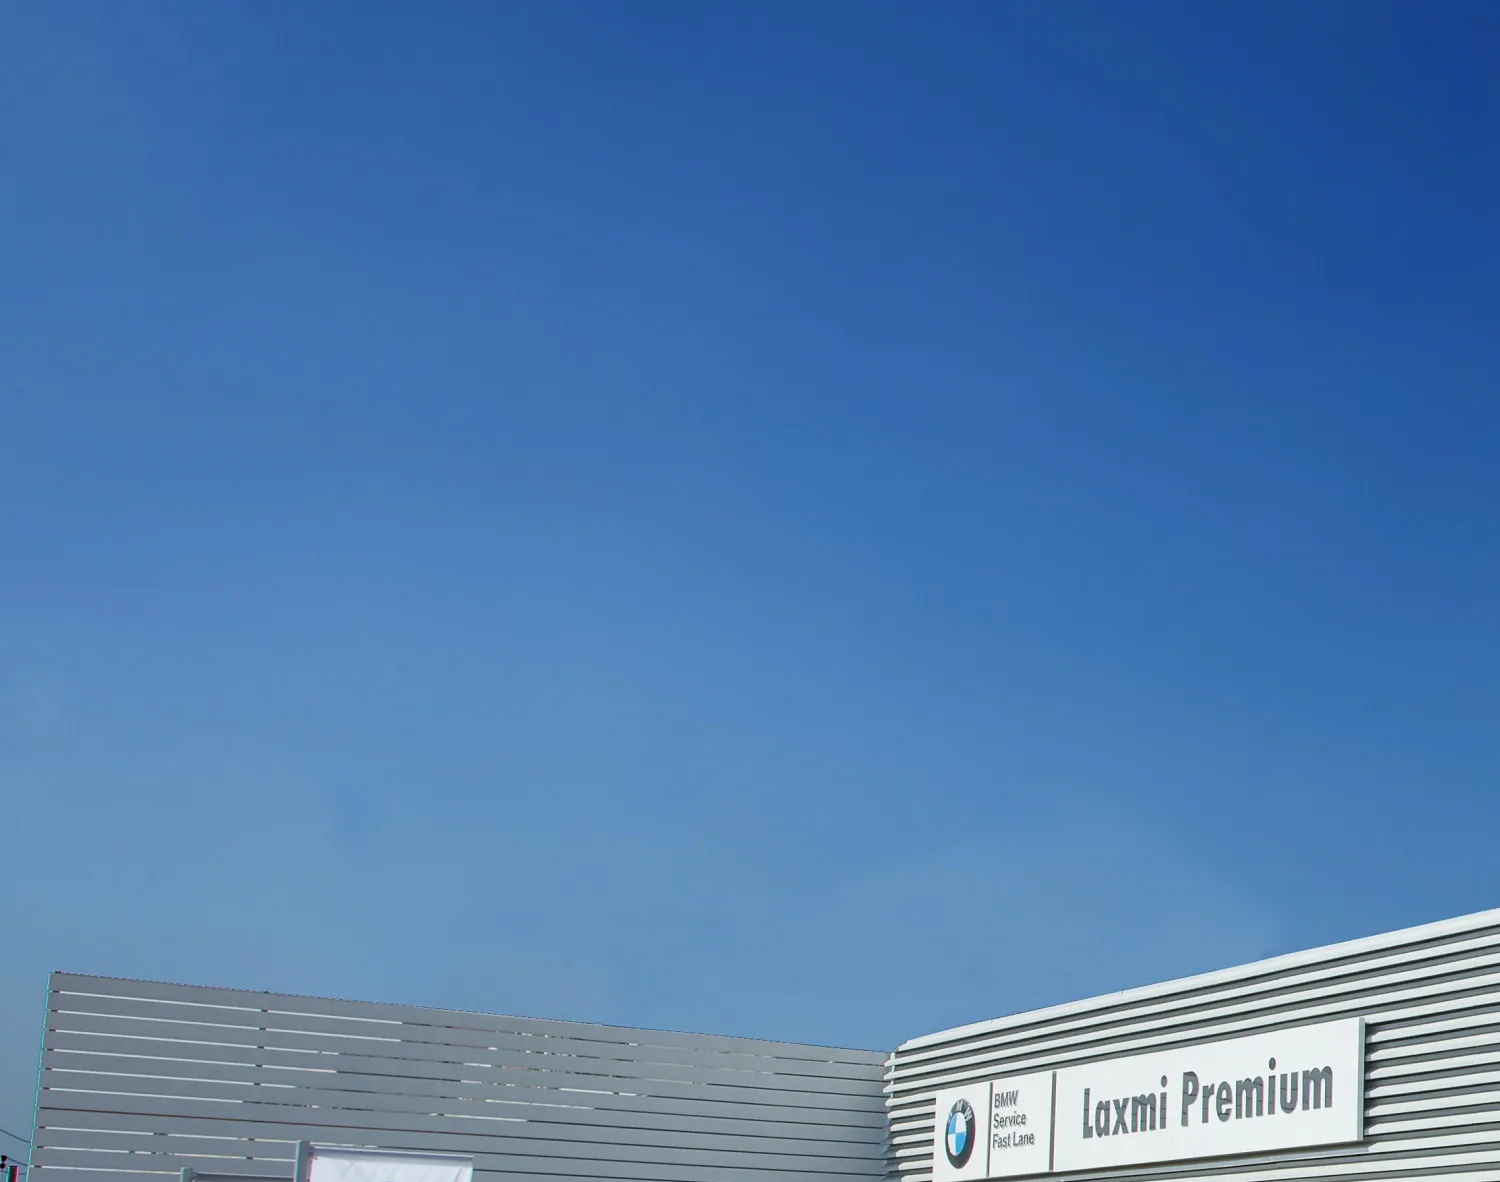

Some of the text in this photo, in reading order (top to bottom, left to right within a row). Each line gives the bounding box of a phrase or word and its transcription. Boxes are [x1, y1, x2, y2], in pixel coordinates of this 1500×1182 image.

[993, 1090, 1019, 1109] BMW
[1082, 1057, 1333, 1139] Laxmi Premium
[993, 1110, 1027, 1129] Service
[992, 1131, 1035, 1149] Fast Lane
